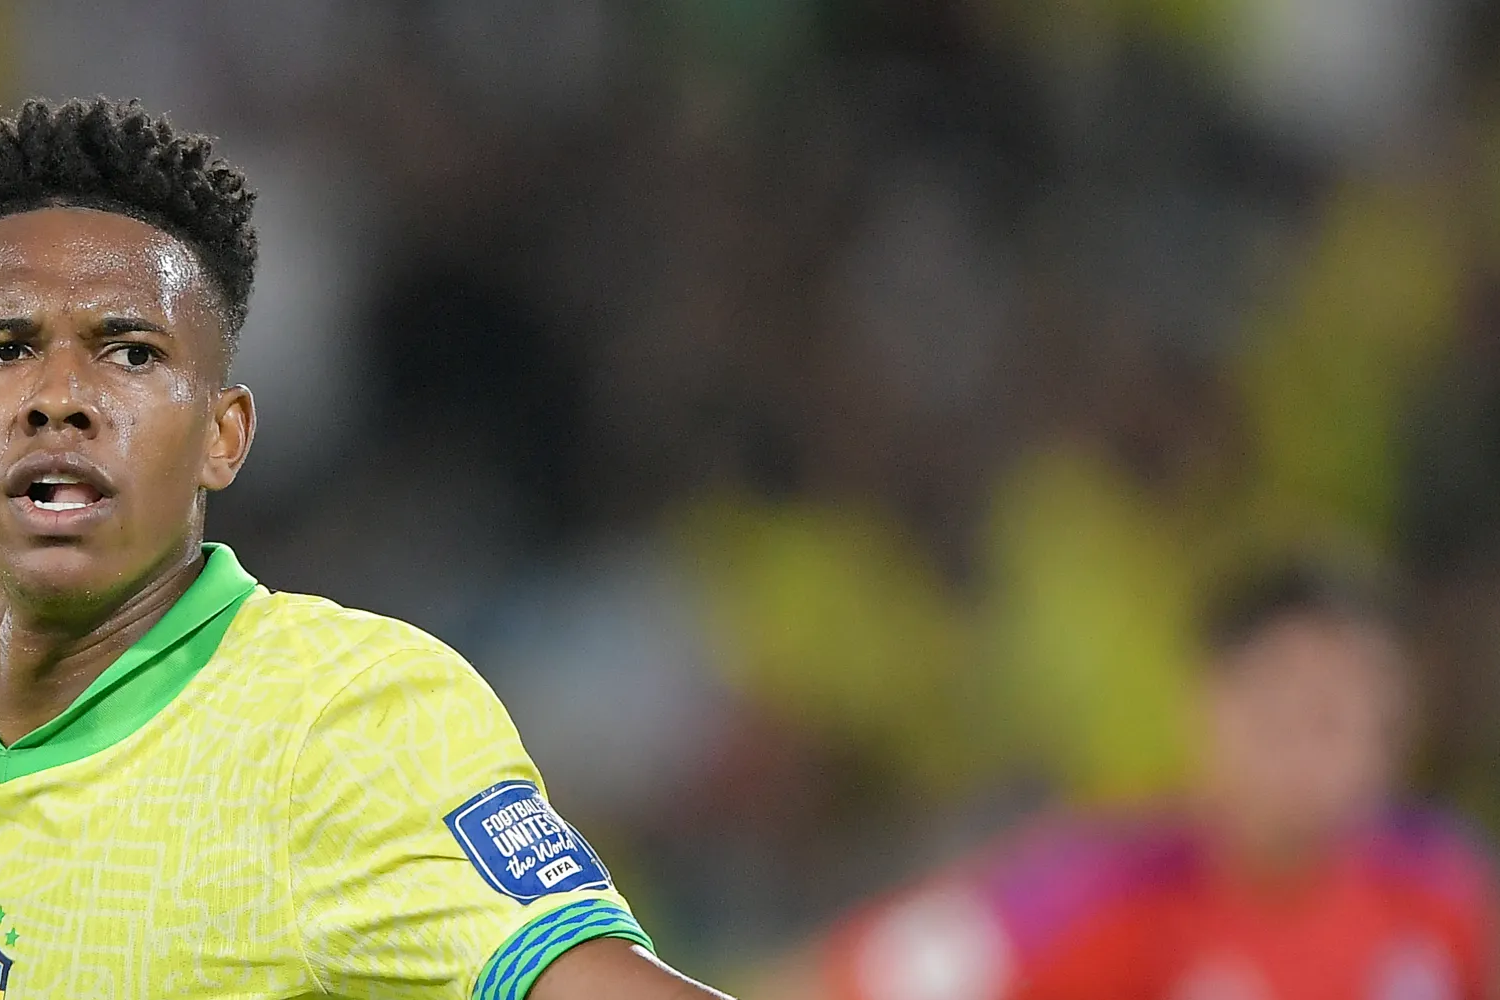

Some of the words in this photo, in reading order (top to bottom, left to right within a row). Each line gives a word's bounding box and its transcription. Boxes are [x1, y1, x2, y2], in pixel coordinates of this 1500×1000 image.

[481, 799, 547, 838] FOOTBALL
[492, 813, 561, 857] UNITES
[506, 855, 536, 879] the
[531, 832, 578, 862] World
[544, 860, 574, 881] FIFA
